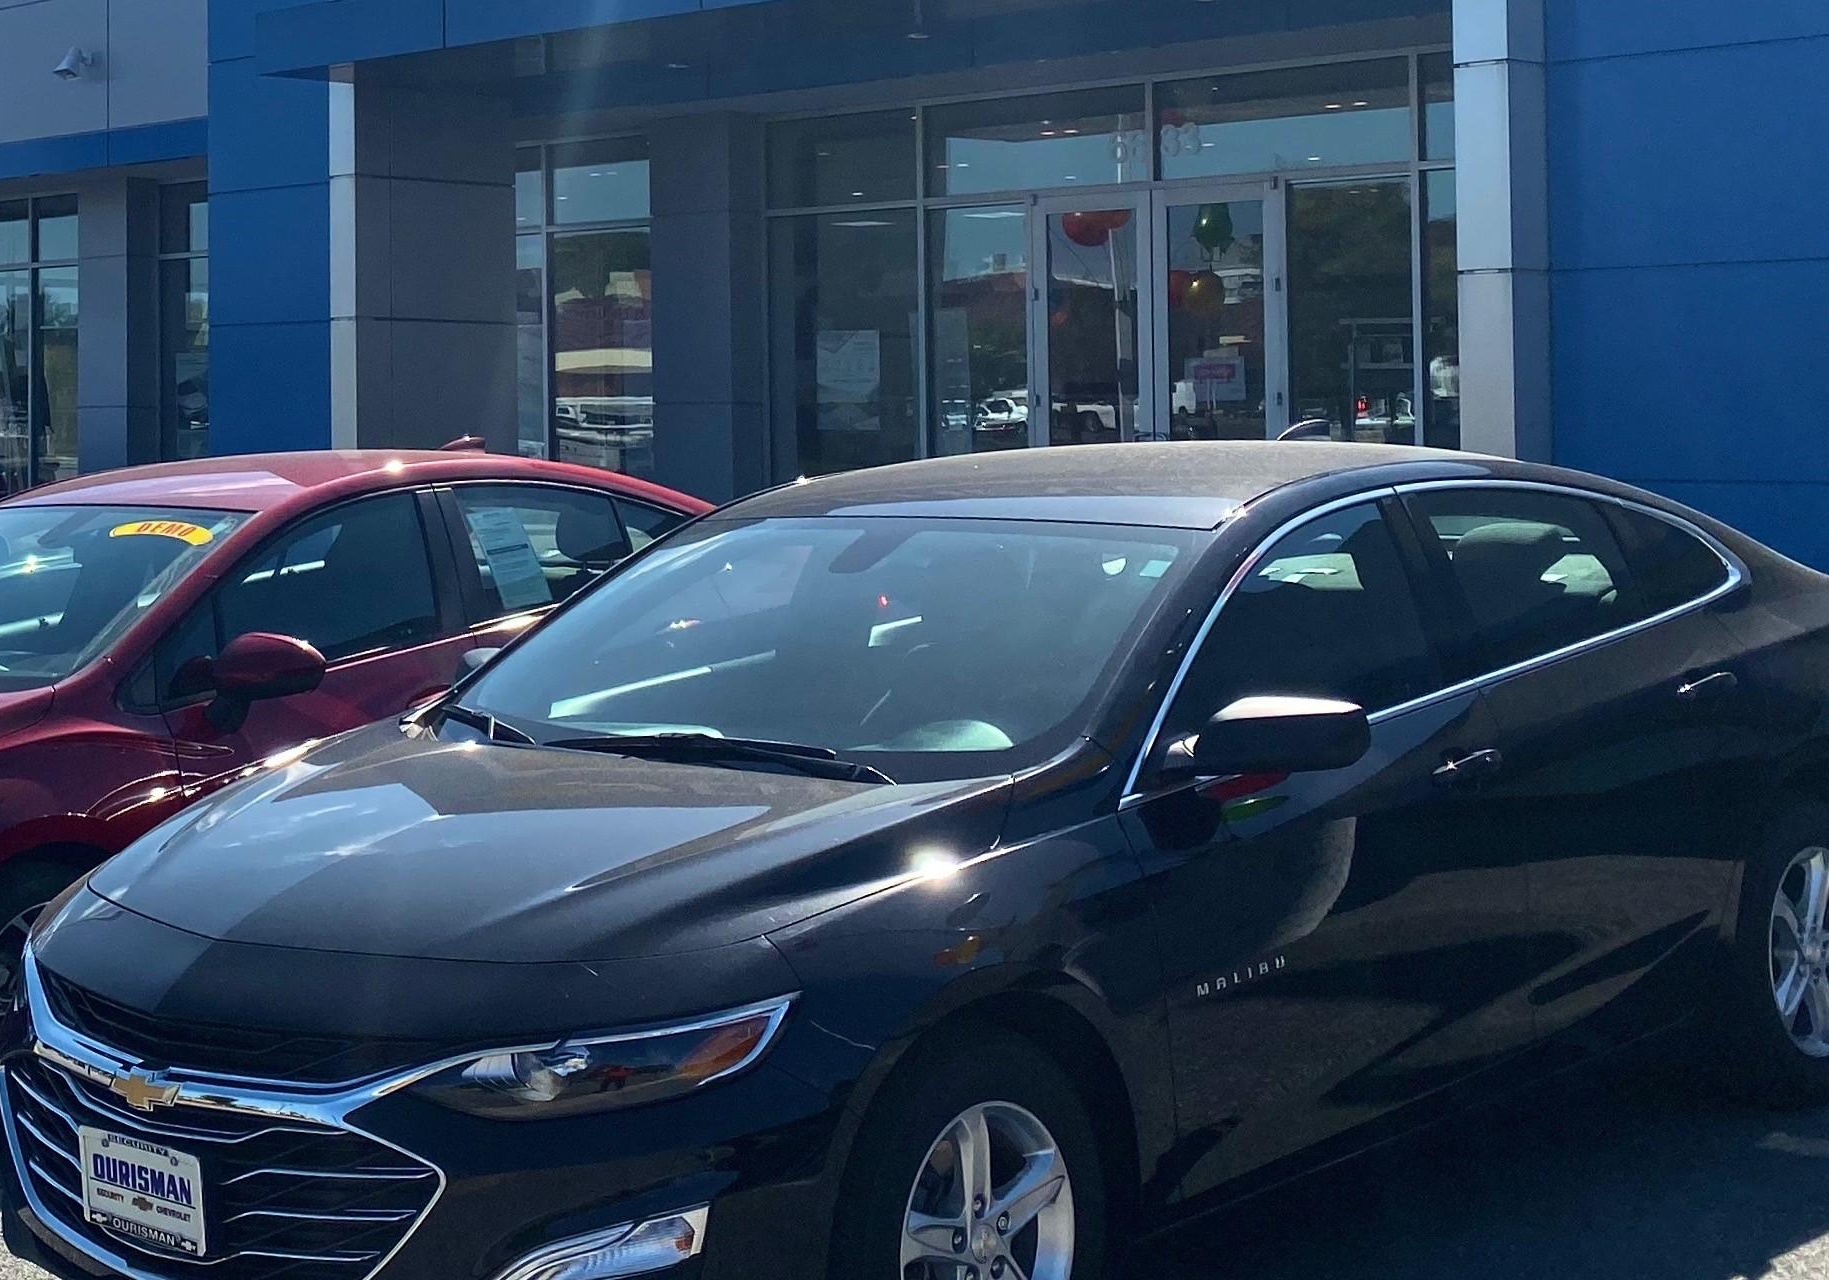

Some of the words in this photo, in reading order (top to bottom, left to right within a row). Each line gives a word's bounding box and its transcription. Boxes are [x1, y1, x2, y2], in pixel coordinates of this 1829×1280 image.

[136, 522, 198, 537] DEMO
[1196, 954, 1286, 998] MALIBU
[92, 1152, 193, 1206] OURISMAN
[112, 1216, 176, 1247] OURISMAN
